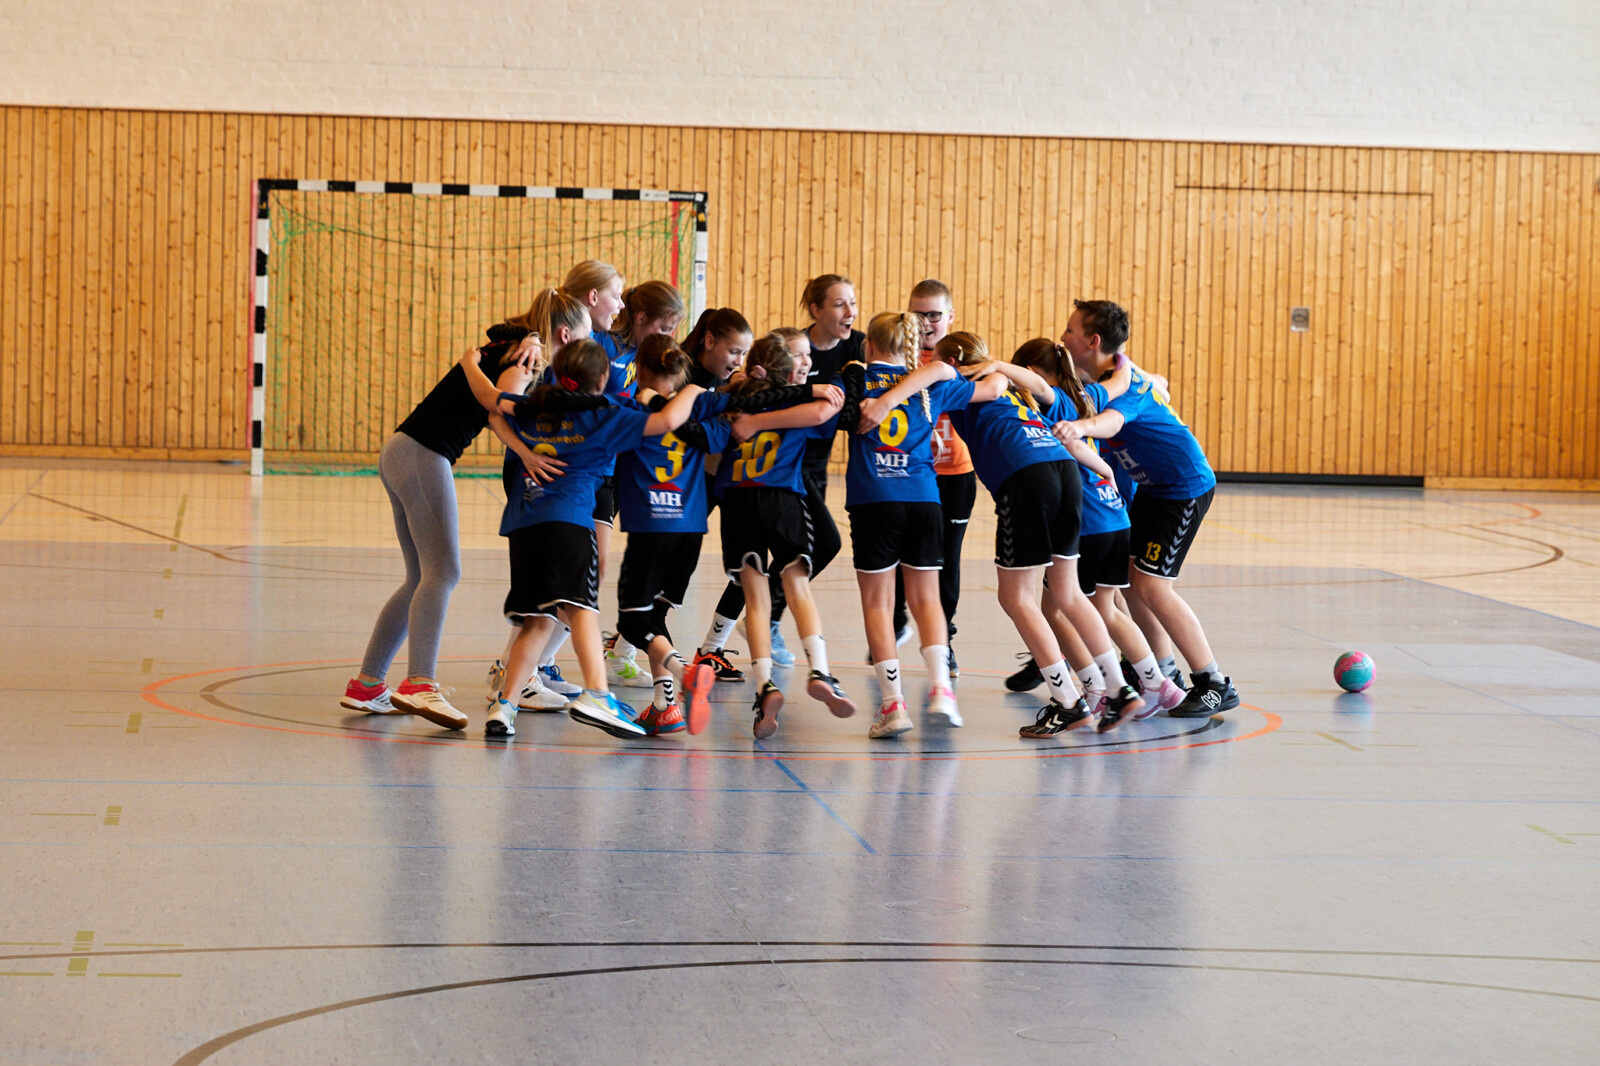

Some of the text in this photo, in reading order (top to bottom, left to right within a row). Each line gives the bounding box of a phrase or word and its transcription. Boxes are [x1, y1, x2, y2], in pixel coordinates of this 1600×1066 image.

[931, 419, 954, 441] H
[655, 431, 687, 483] 3
[732, 431, 782, 482] 10
[875, 452, 911, 468] MH
[649, 490, 683, 507] MH
[1145, 541, 1162, 562] 13
[657, 708, 682, 726] Kem
